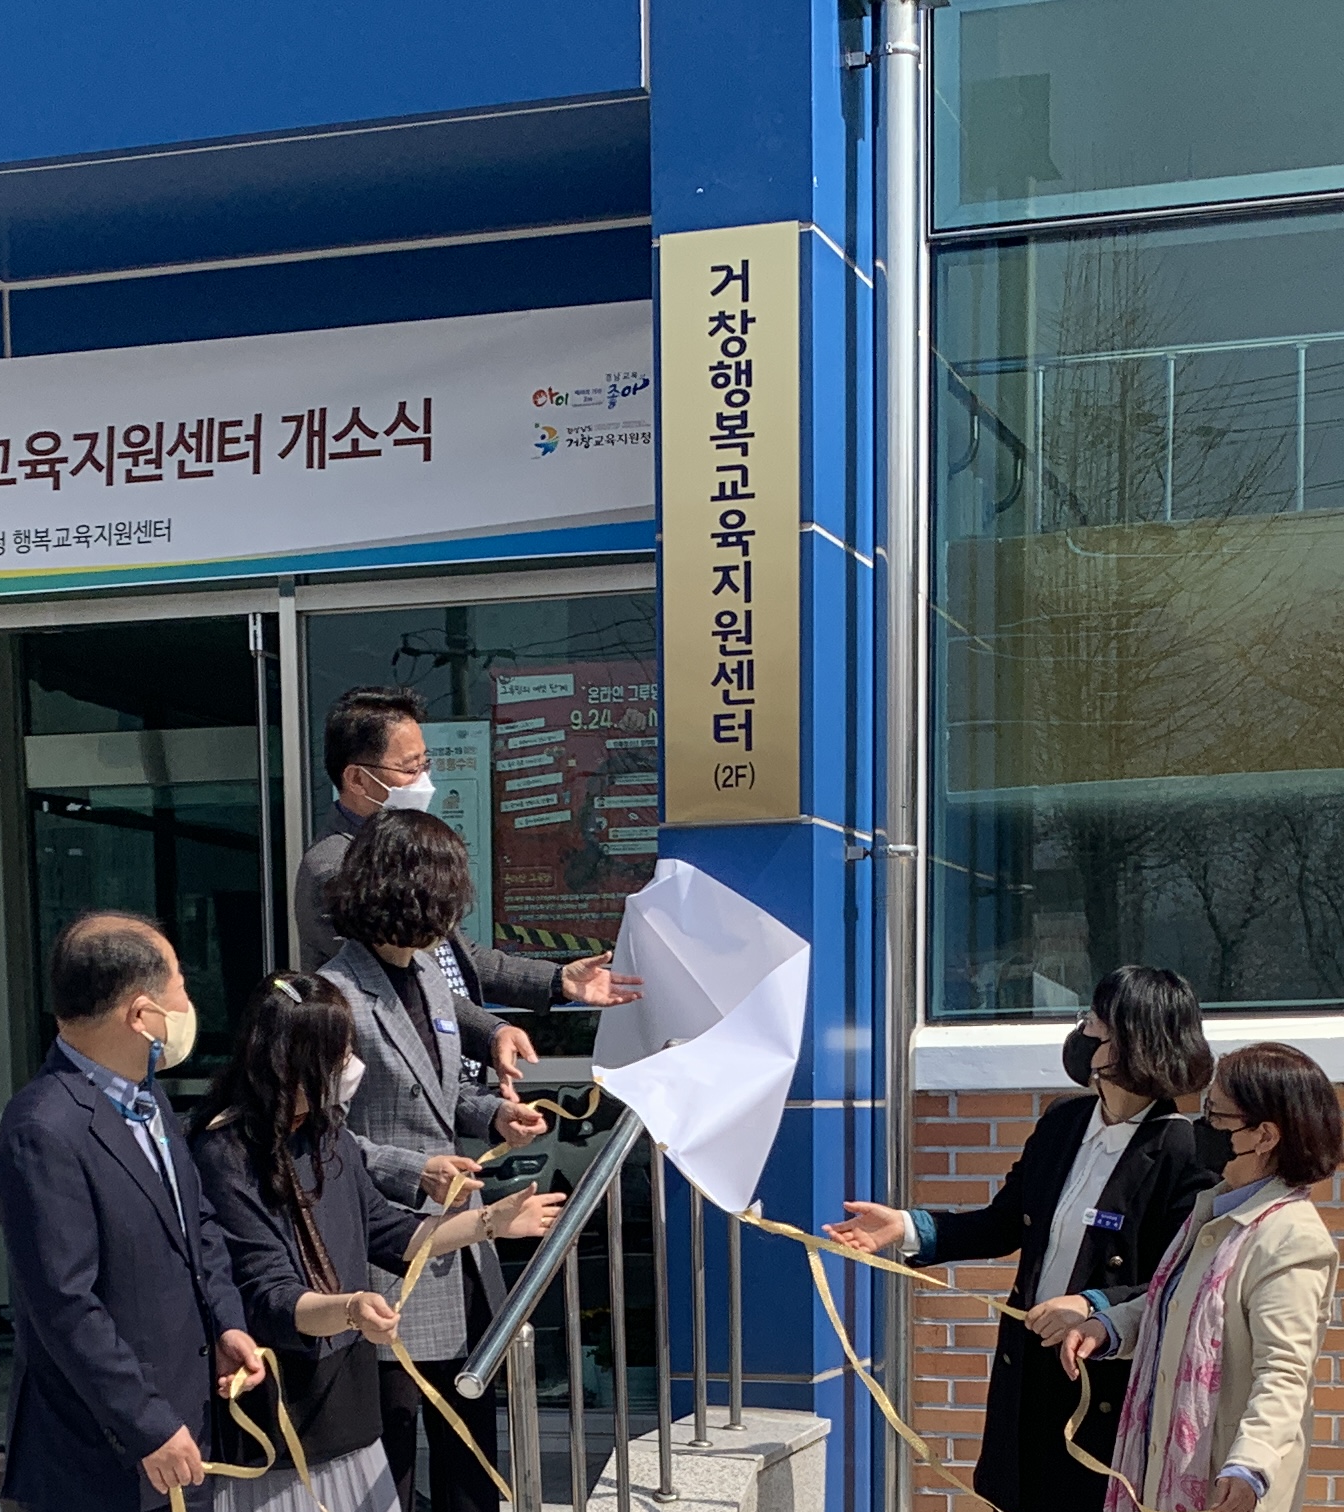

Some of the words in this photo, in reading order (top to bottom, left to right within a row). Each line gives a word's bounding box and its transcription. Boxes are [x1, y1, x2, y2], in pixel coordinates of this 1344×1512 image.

[277, 398, 432, 470] 개소식
[565, 431, 652, 449] 거창교육지원청
[708, 259, 756, 751] 거창행복교육지원센터
[13, 518, 172, 555] 행복교육지원센터
[588, 686, 624, 704] 온라인
[714, 761, 755, 791] (2F)
